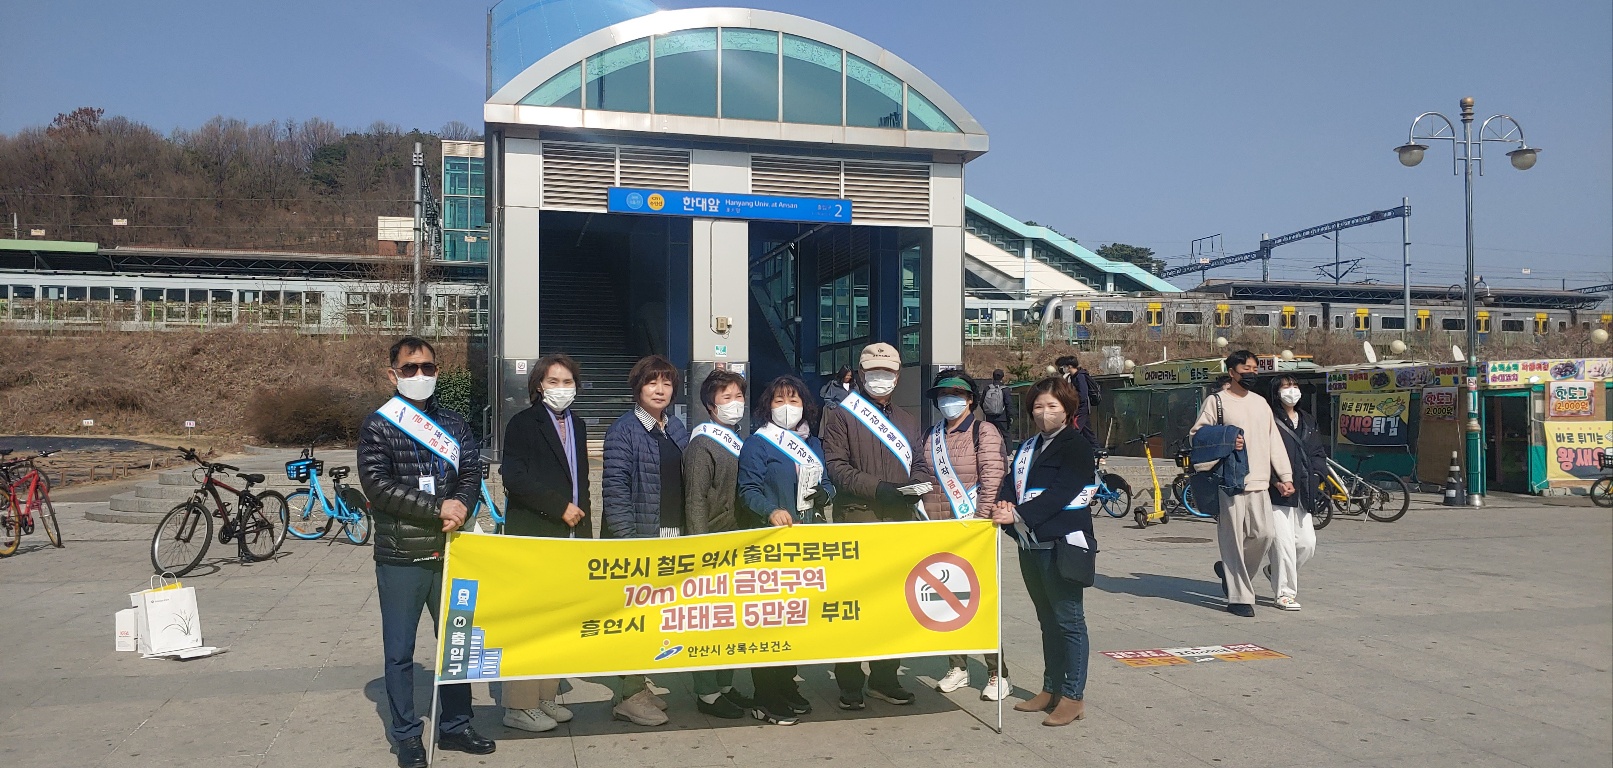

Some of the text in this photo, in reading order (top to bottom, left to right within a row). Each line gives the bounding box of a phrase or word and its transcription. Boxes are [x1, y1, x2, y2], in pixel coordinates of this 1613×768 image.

[683, 196, 720, 213] 한대앞
[725, 199, 753, 209] Hanyang
[754, 200, 771, 208] Univ.
[834, 204, 842, 218] 2
[1144, 370, 1177, 382] 아메리카노
[1425, 391, 1454, 406] 핫도그
[1555, 386, 1588, 401] 핫도그
[1426, 406, 1454, 417] 2,000원
[1556, 401, 1590, 412] 2,000원
[861, 407, 905, 451] 건강생활의
[1340, 414, 1400, 437] 왕새우튀김
[1556, 432, 1604, 445] 바로 튀기는
[946, 478, 963, 500] 금연
[588, 540, 860, 581] 안산시 철도 역사 출입구로부터
[624, 567, 827, 608] 10m 이내 금연구역
[580, 599, 861, 638] 흡연시 과태료 5만원 부과
[448, 632, 466, 676] 출입구
[687, 640, 792, 658] 안산시 상록수보건소
